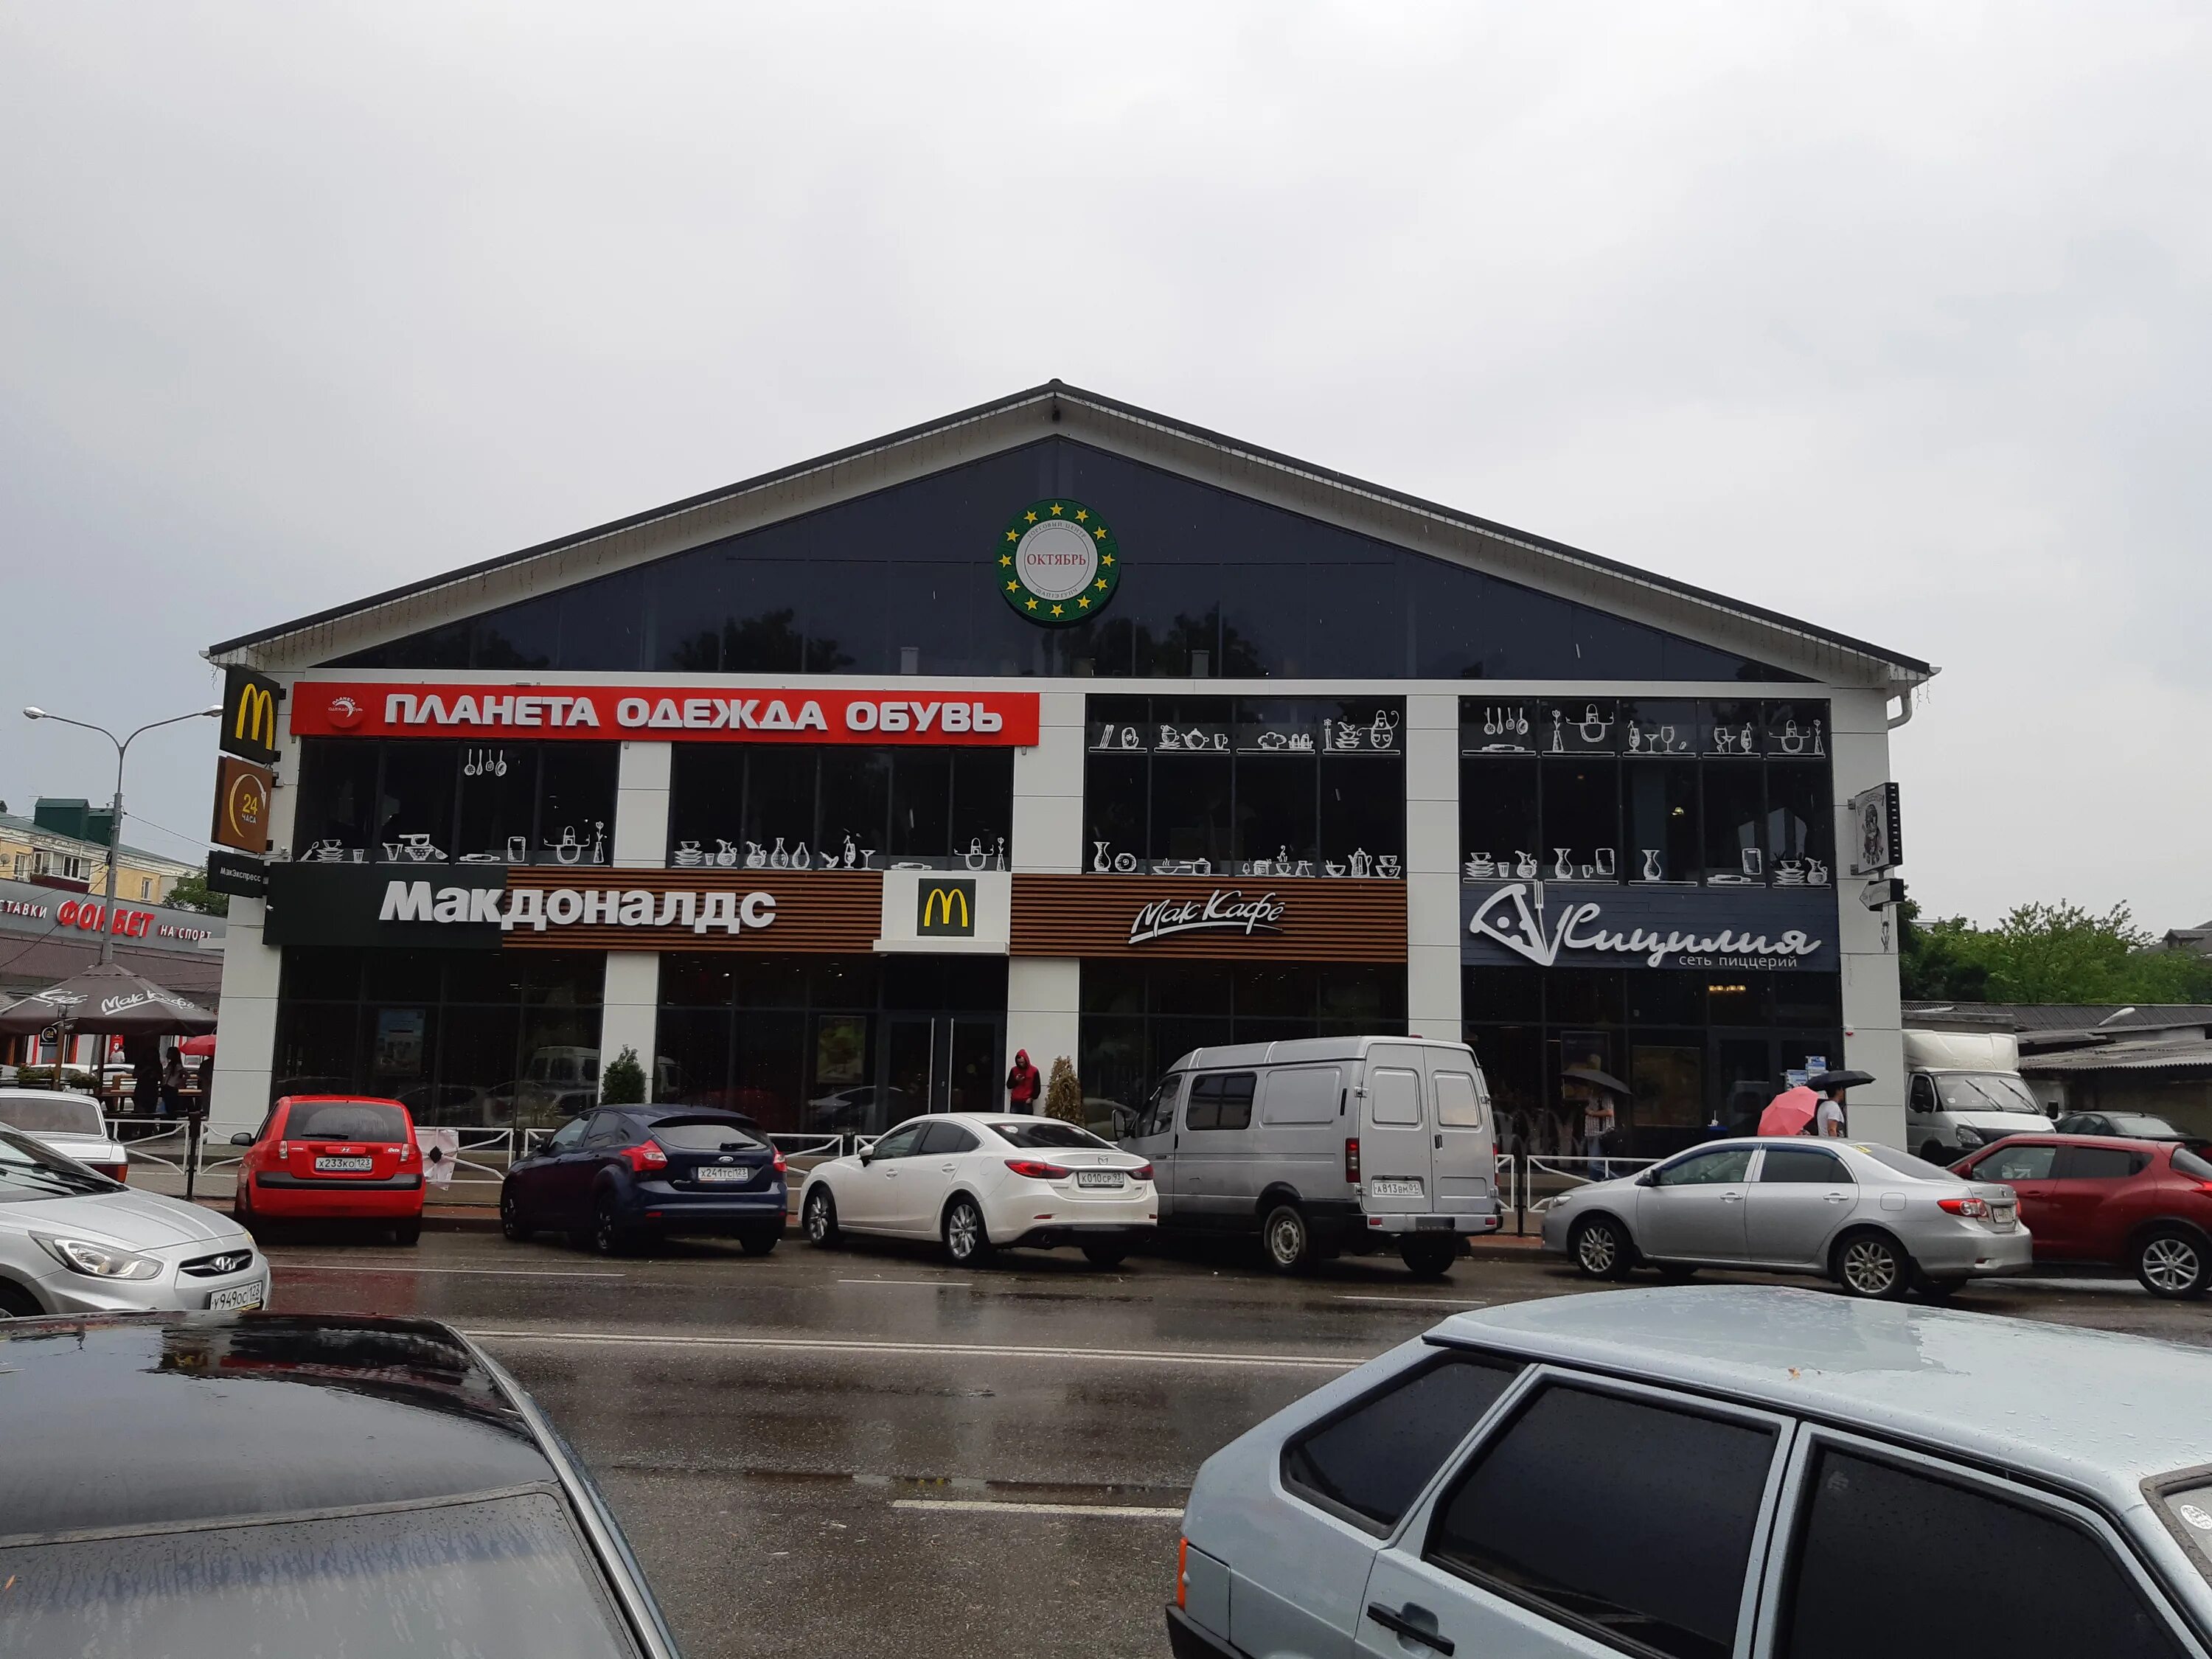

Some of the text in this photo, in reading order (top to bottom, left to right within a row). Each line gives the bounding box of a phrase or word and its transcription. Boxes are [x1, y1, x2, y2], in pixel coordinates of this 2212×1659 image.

[1026, 553, 1087, 566] ОКТЯБРЬ
[385, 693, 1003, 732] ПЛАНЕТА ОДЕЖДА ОБУВЬ
[242, 793, 258, 815] 24
[242, 813, 257, 824] ЧАСА
[220, 866, 262, 883] МакЭкспресс
[379, 880, 776, 934] Макдоналдс
[160, 925, 174, 937] НА
[178, 928, 212, 941] СПОРТ
[1564, 902, 1822, 967] Сицилия
[1678, 955, 1797, 970] сеть пиццерий
